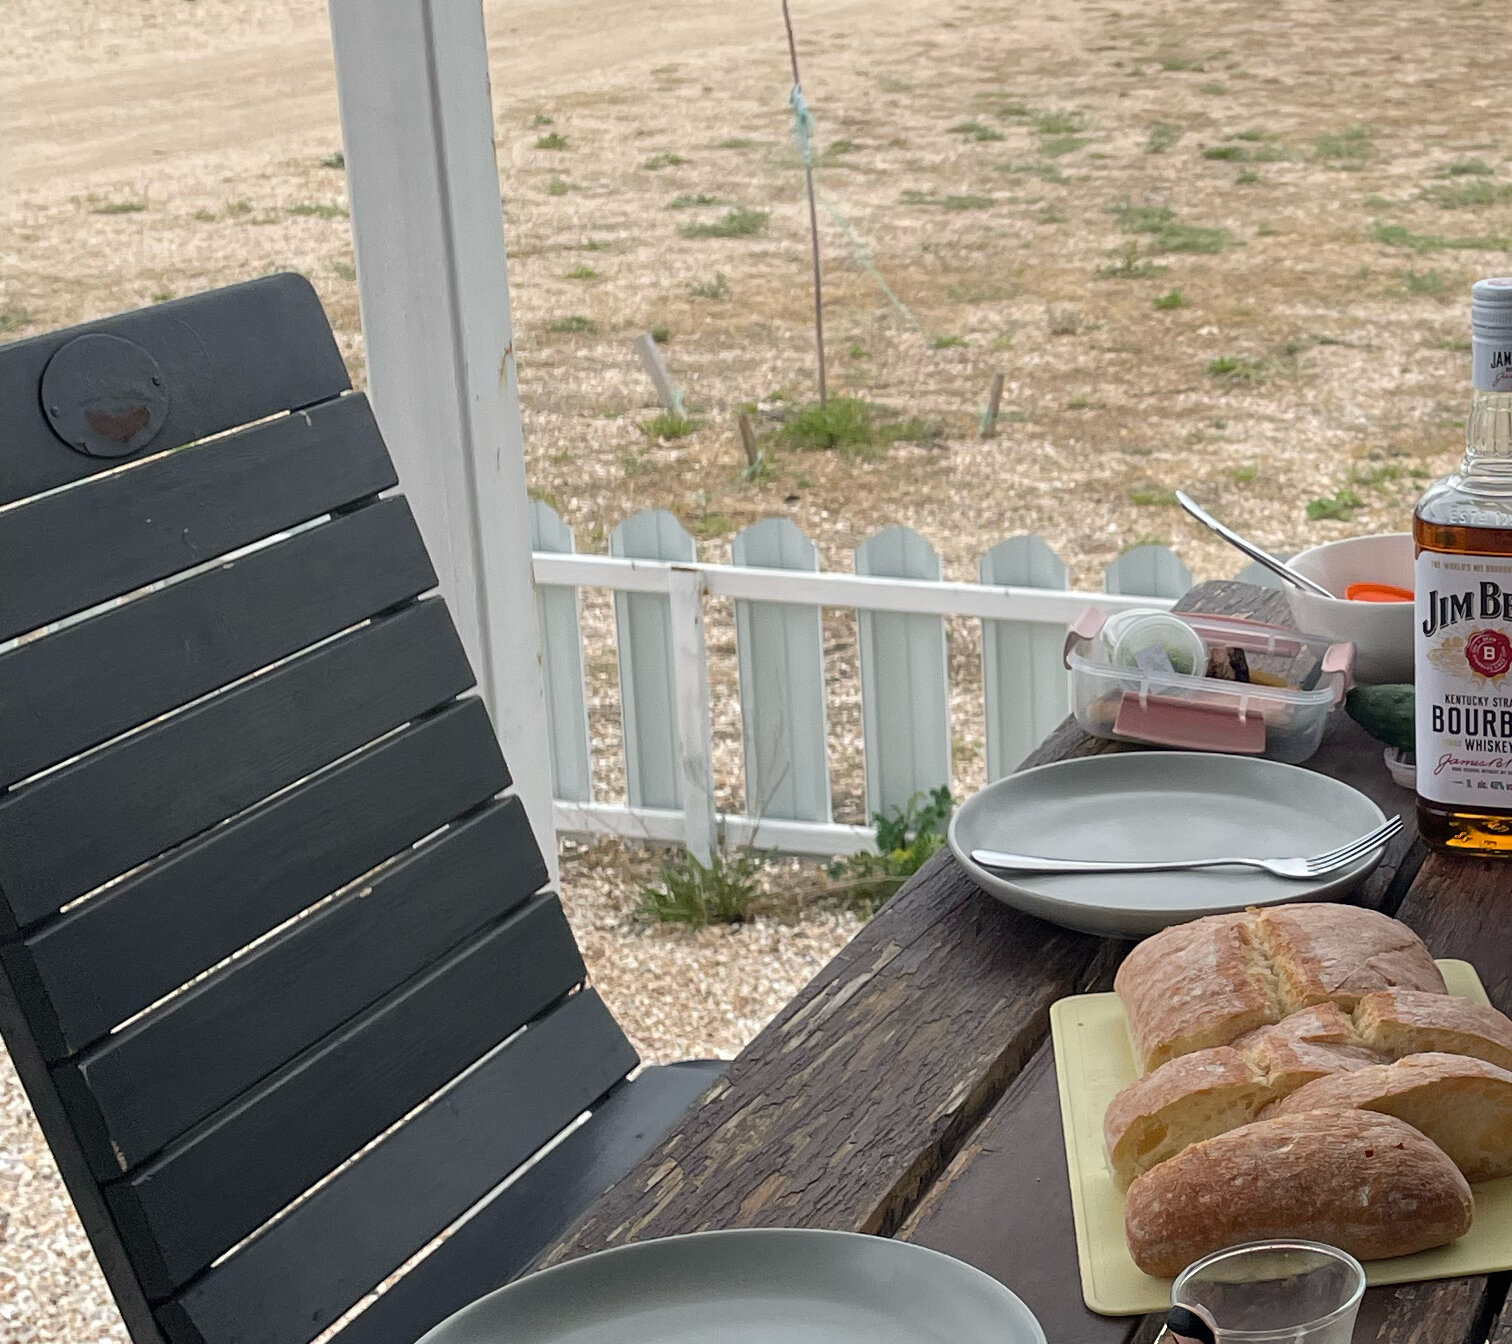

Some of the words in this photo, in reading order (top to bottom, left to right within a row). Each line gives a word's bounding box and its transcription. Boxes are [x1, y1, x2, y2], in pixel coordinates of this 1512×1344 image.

[1422, 589, 1475, 638] JIM
[1483, 645, 1496, 661] B
[1444, 693, 1490, 707] KENTUCKY
